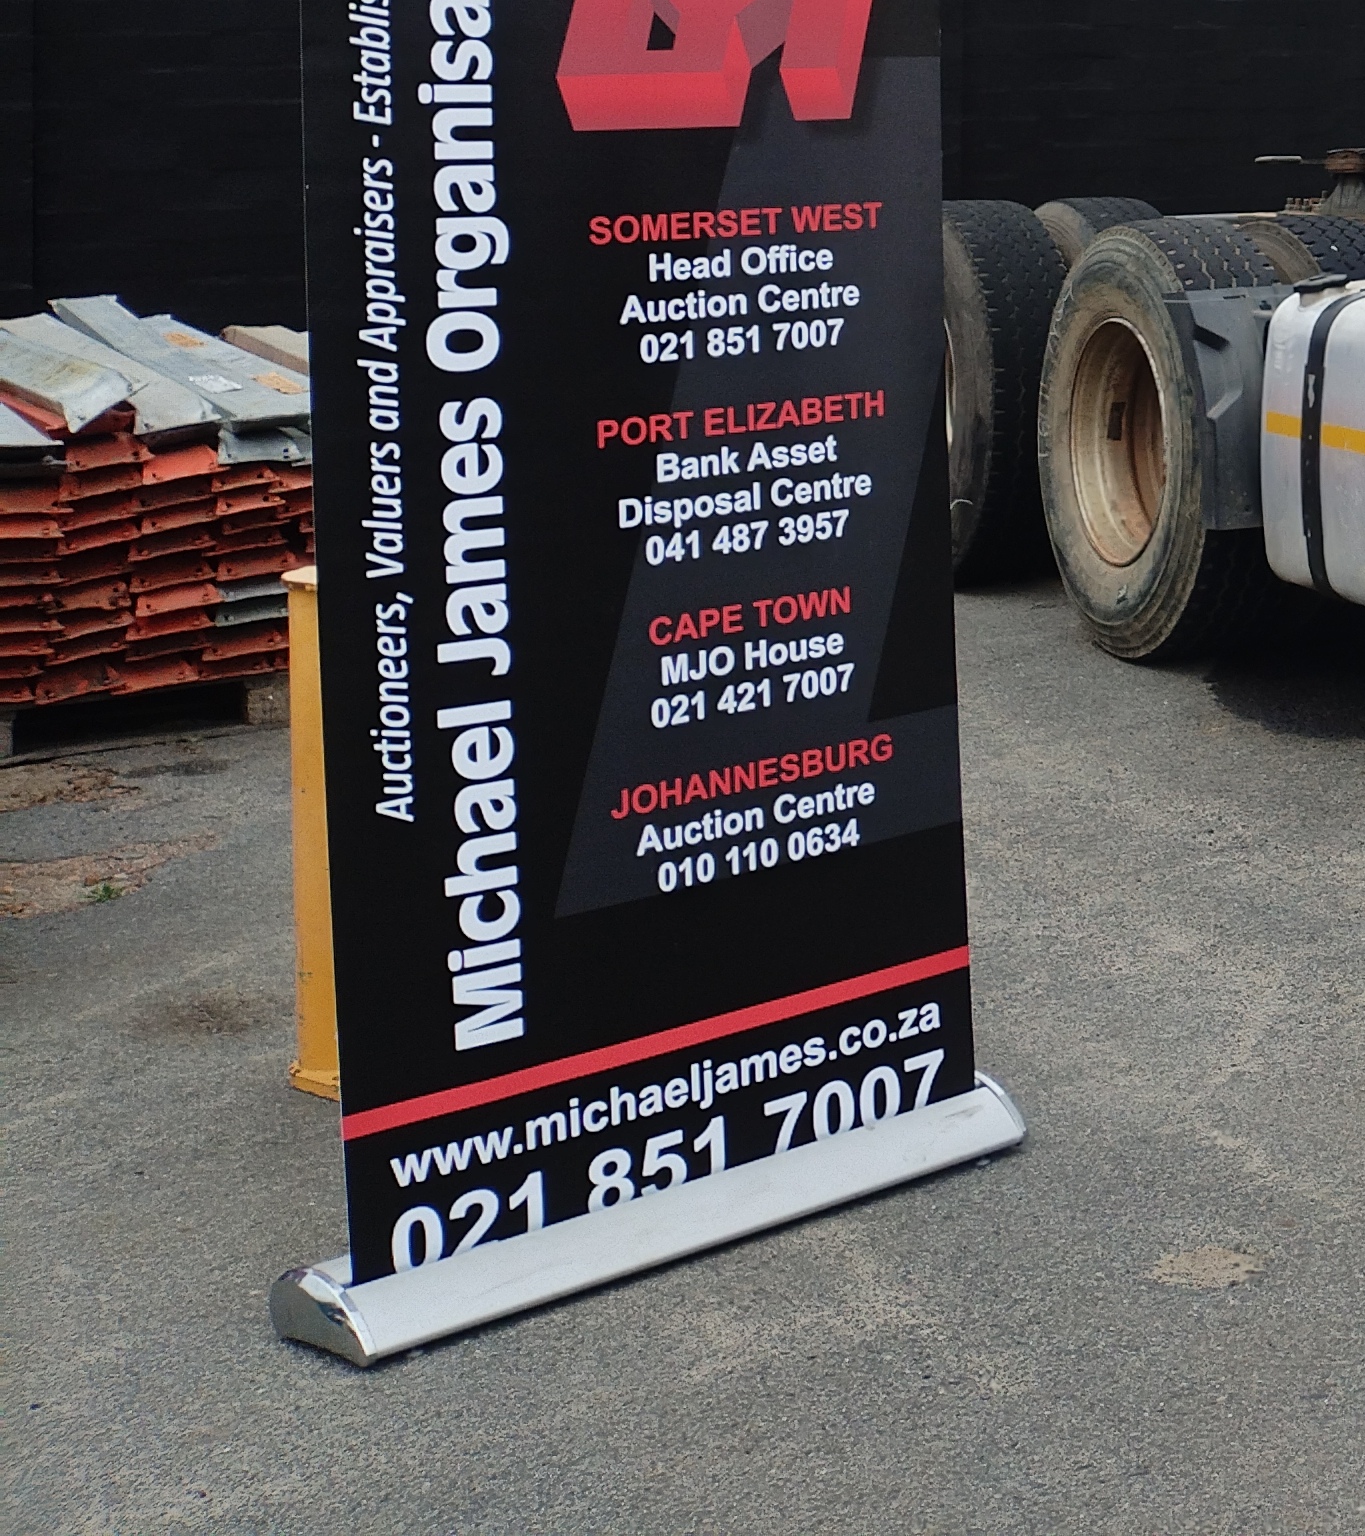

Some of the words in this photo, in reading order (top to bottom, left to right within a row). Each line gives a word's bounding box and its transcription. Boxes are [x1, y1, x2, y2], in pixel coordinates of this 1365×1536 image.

[354, 158, 406, 352] Appraisers
[589, 207, 782, 245] SOMERSET
[791, 201, 882, 234] WEST
[649, 249, 731, 282] Head
[741, 244, 833, 275] Office
[619, 290, 747, 325] Auction
[758, 282, 860, 313] Centre
[640, 330, 694, 363] 021
[707, 325, 760, 357] 851
[772, 318, 844, 351] 7007
[357, 359, 399, 431] and
[596, 411, 694, 449] PORT
[705, 390, 885, 437] ELIZABETH
[656, 446, 740, 483] Bank
[748, 434, 838, 471] Asset
[361, 442, 405, 579] Valuers
[618, 481, 761, 529] Disposal
[771, 472, 872, 508] Centre
[437, 396, 511, 676] James
[646, 530, 700, 565] 041
[712, 520, 769, 555] 487
[778, 509, 849, 546] 3957
[649, 604, 744, 646] CAPE
[753, 586, 850, 627] TOWN
[661, 645, 735, 687] MJO
[744, 632, 844, 671] House
[370, 592, 415, 822] Auctioneers,
[651, 691, 705, 729] 021
[717, 678, 771, 715] 421
[783, 663, 855, 702] 7007
[611, 733, 894, 820] JOHANNESBURG
[636, 807, 764, 857] Auction
[774, 782, 875, 824] Centre
[437, 699, 524, 1052] Michael
[658, 853, 715, 893] 010
[725, 838, 779, 875] 110
[788, 818, 860, 861] 0634
[389, 1002, 941, 1187] www.michaeljames.co.za
[391, 1171, 544, 1274] 021
[588, 1115, 727, 1216] 851
[764, 1049, 945, 1155] 7007
